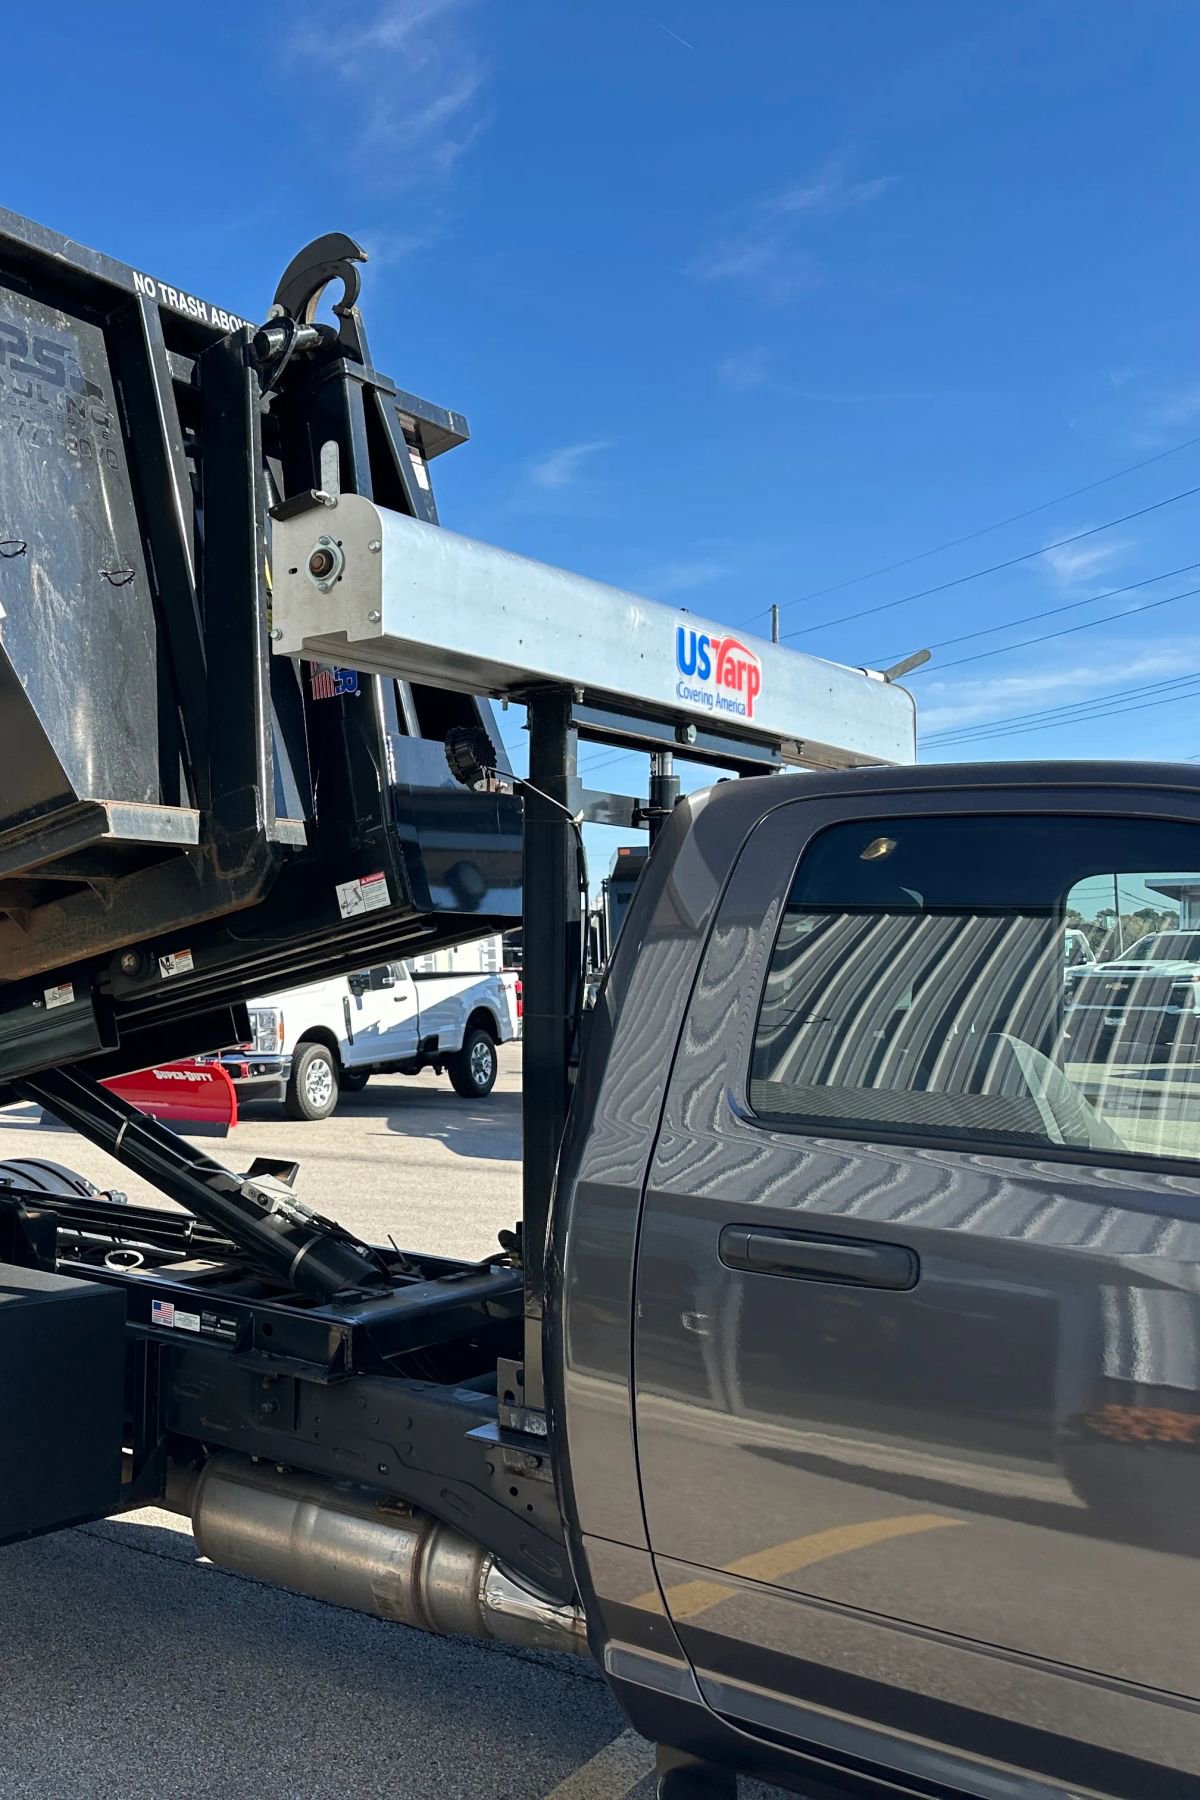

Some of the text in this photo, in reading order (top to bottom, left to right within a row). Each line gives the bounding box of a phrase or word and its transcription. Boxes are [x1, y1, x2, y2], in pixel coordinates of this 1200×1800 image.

[132, 271, 255, 333] NO TRASH ABO
[43, 409, 112, 441] SERVE
[677, 680, 746, 716] Covering America
